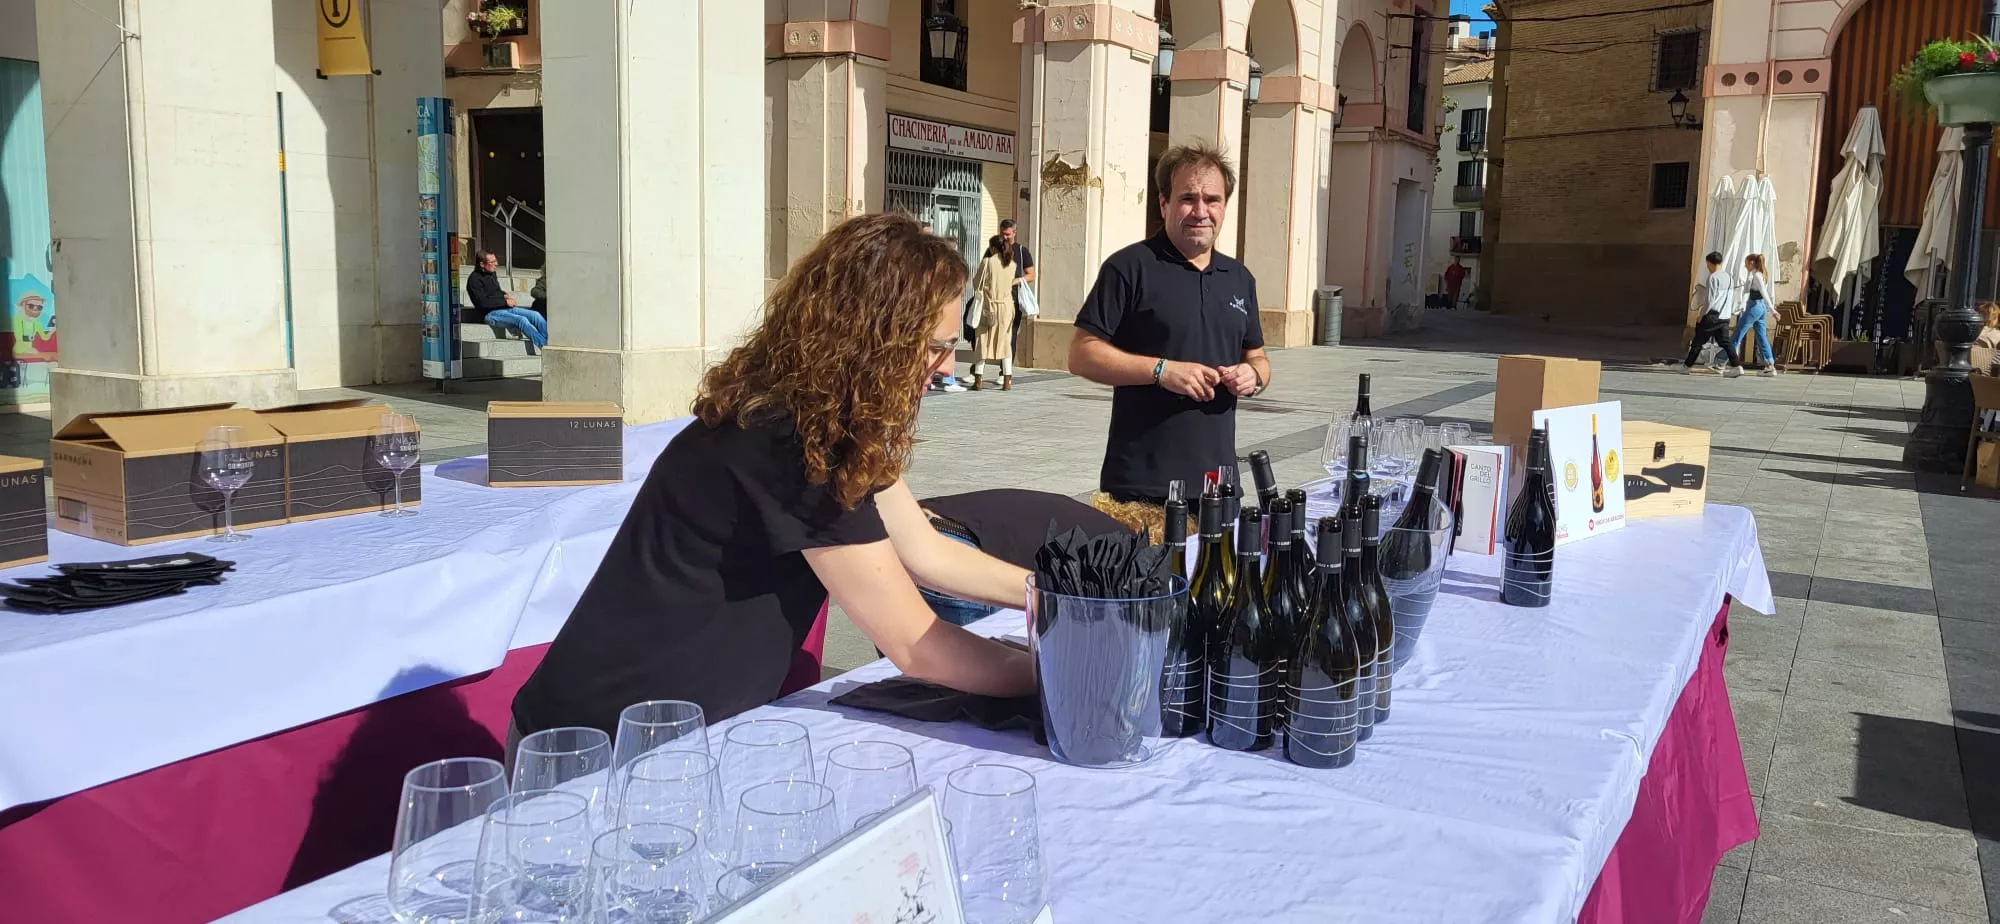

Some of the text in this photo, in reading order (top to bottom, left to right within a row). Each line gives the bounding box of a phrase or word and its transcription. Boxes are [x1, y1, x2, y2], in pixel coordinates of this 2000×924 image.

[892, 118, 947, 144] CHACINERIA
[963, 130, 993, 151] AMADO
[995, 135, 1012, 155] ARA
[569, 420, 616, 429] 12 LUNAS
[239, 448, 278, 460] LUNAS
[1470, 463, 1491, 472] CANTO
[1470, 475, 1490, 484] GRILLO
